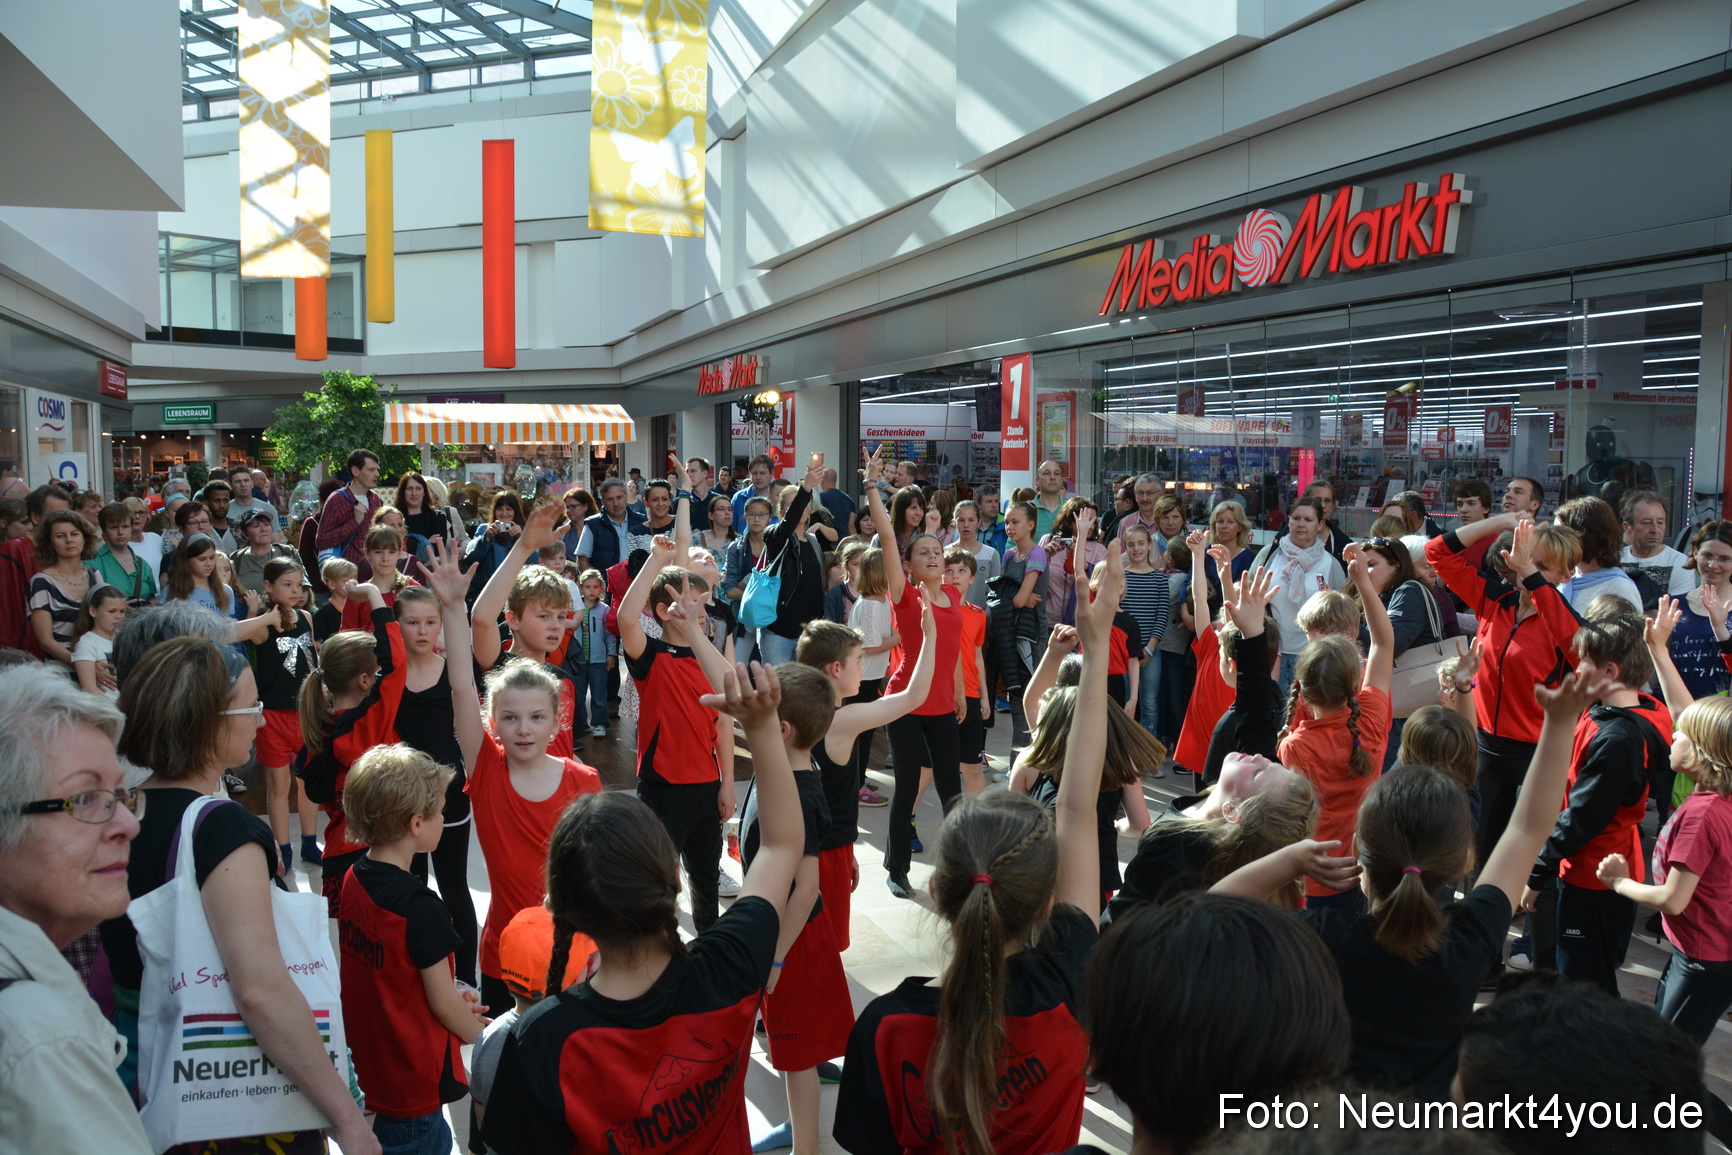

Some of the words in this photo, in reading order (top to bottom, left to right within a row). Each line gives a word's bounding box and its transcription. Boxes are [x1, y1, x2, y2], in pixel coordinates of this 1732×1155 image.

[1099, 233, 1236, 316] Media
[1268, 172, 1465, 284] Markt
[696, 363, 724, 396] Media
[729, 354, 759, 390] Markt
[1010, 363, 1023, 419] 1
[38, 397, 65, 420] COSMO
[167, 409, 209, 417] LEBENSRAUM
[786, 397, 792, 434] 1
[866, 428, 925, 437] Geschenkideen
[1007, 425, 1024, 435] Stunde
[1486, 411, 1509, 433] 0%
[168, 972, 187, 995] Viel
[181, 1088, 239, 1102] einkaufen
[246, 1084, 276, 1096] leben
